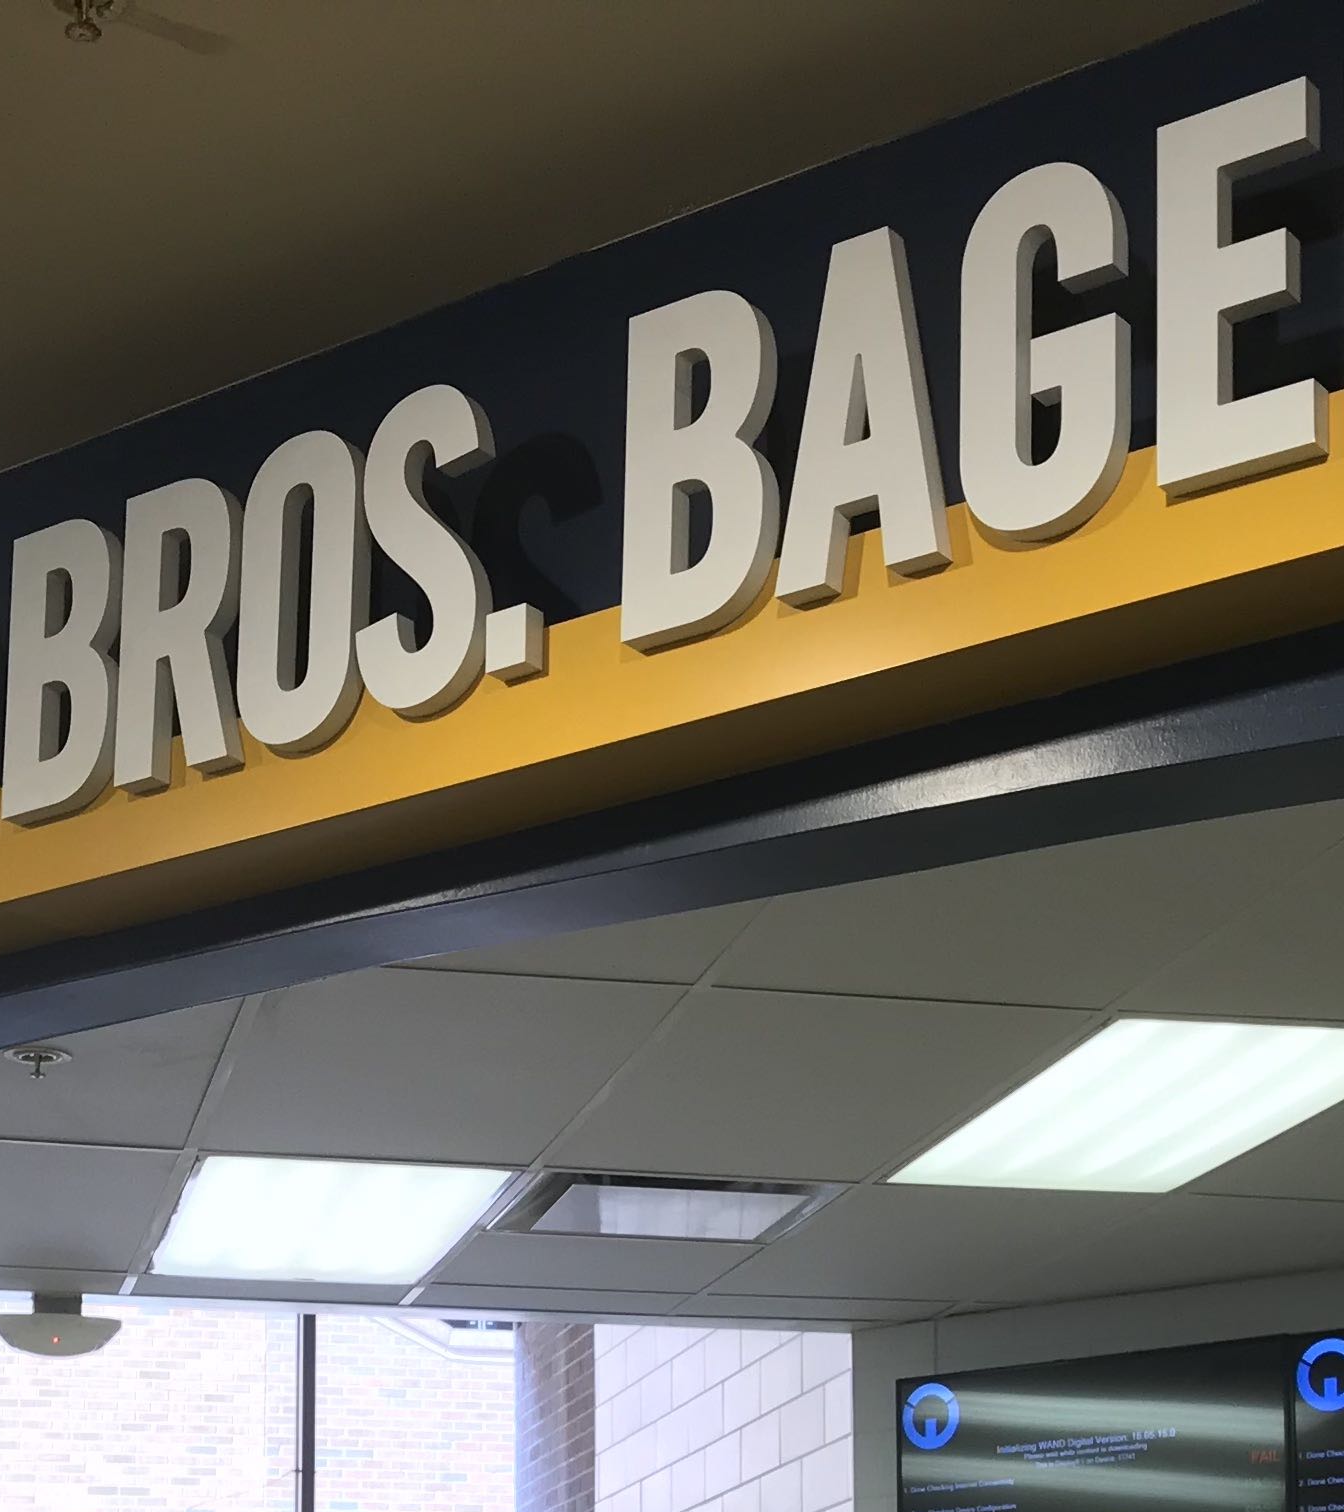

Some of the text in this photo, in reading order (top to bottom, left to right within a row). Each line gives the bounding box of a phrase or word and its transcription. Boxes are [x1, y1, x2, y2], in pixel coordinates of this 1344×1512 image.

[2, 384, 549, 827] BROS.
[1038, 1437, 1093, 1449] WAND Digital
[1250, 1451, 1280, 1464] FAIL
